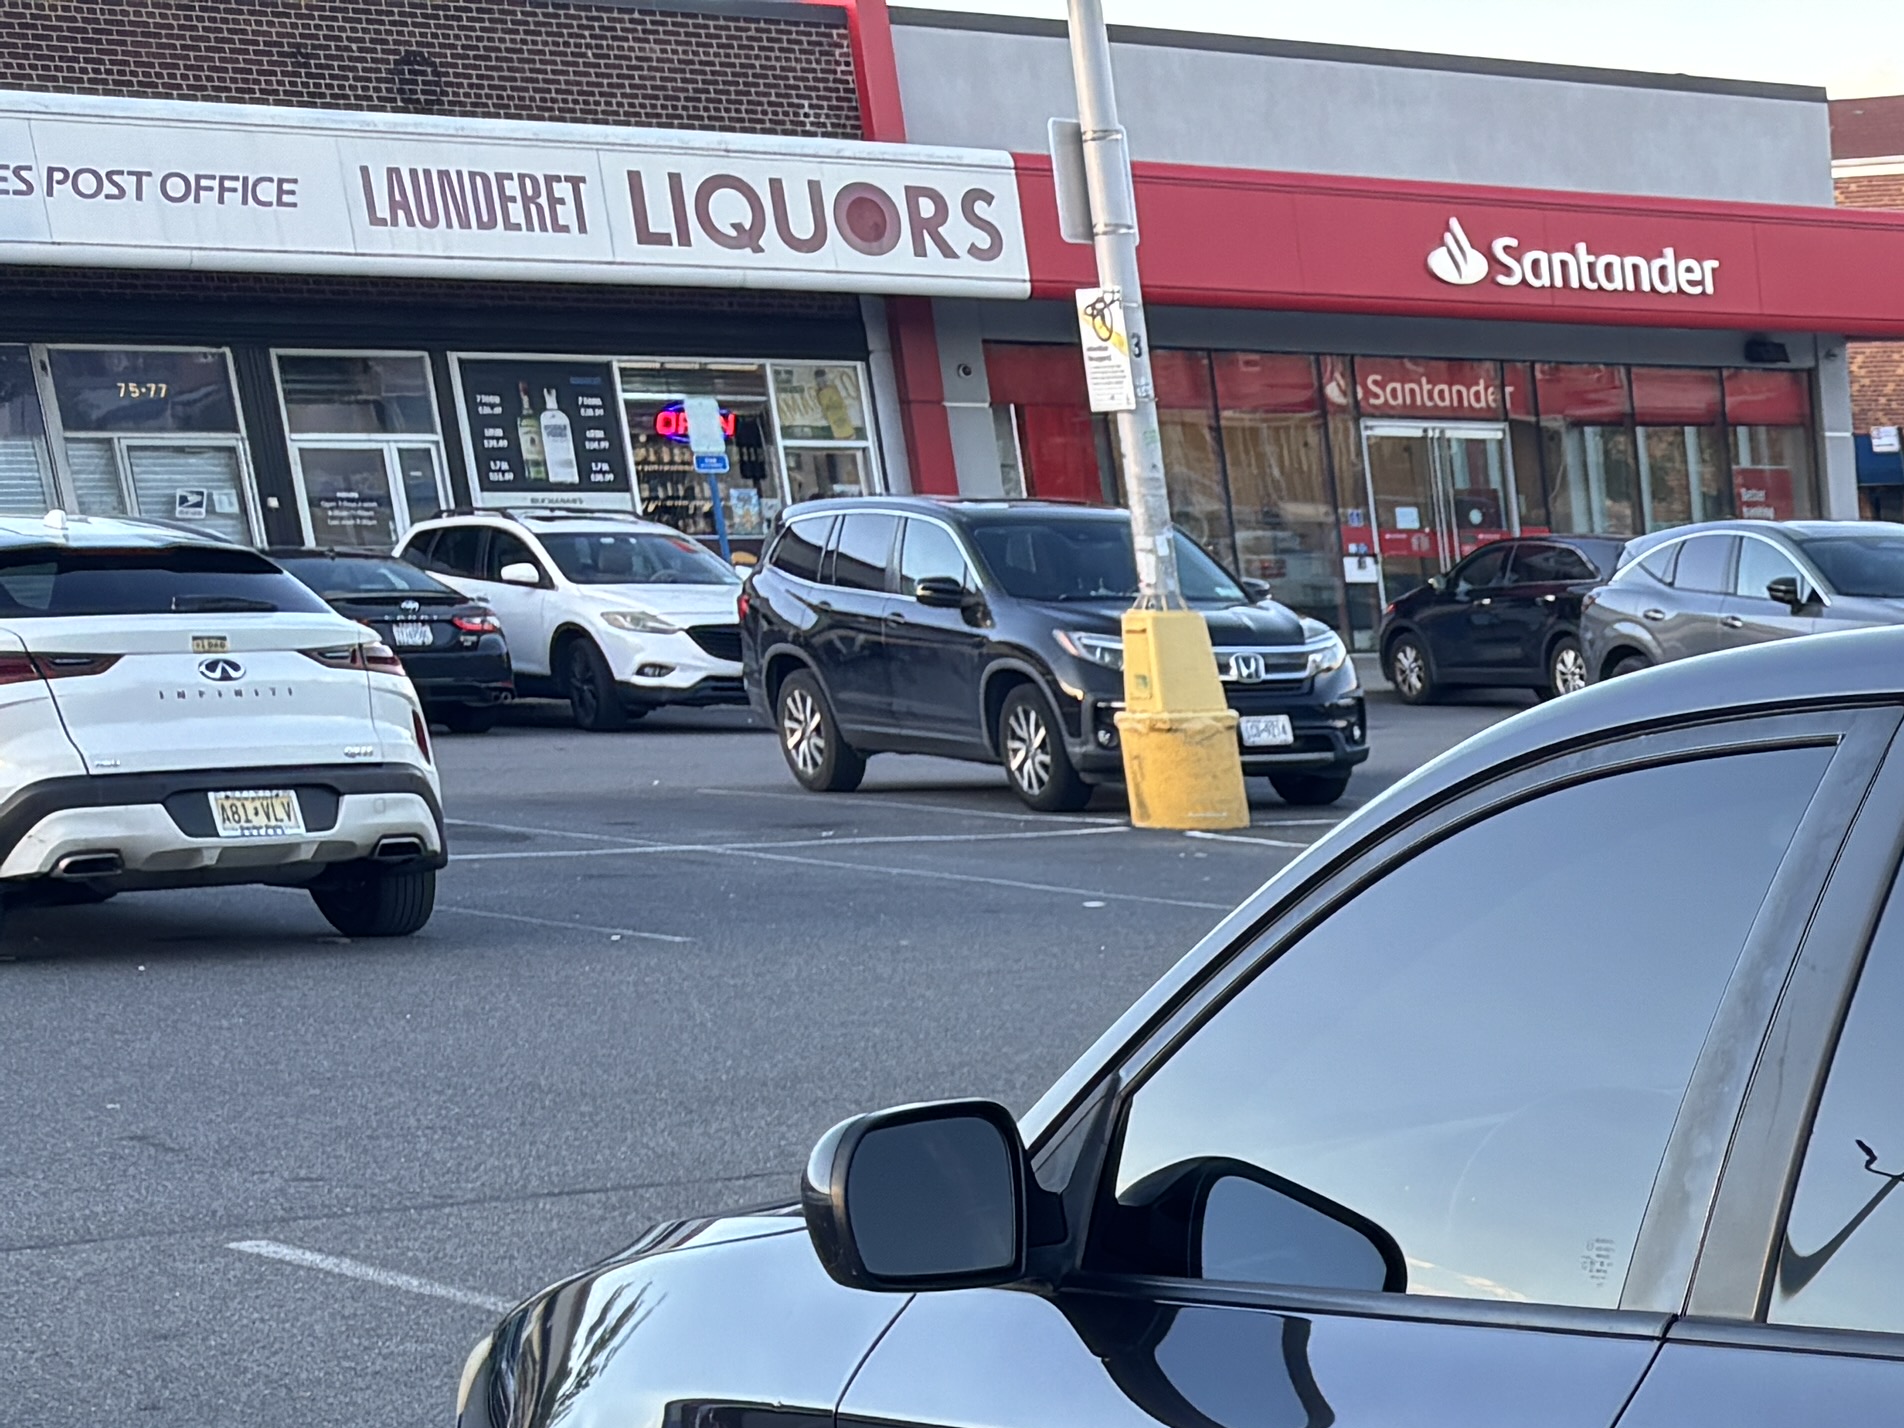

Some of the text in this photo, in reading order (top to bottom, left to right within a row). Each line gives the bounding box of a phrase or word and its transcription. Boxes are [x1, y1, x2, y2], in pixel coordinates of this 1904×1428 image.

[46, 166, 153, 202] POST
[159, 170, 299, 208] OFFICE
[359, 164, 587, 235] LAUNDERET
[626, 168, 1003, 262] LIQUORS
[1492, 236, 1720, 296] Santander
[1366, 372, 1515, 412] Santander
[159, 687, 294, 699] INFINITI
